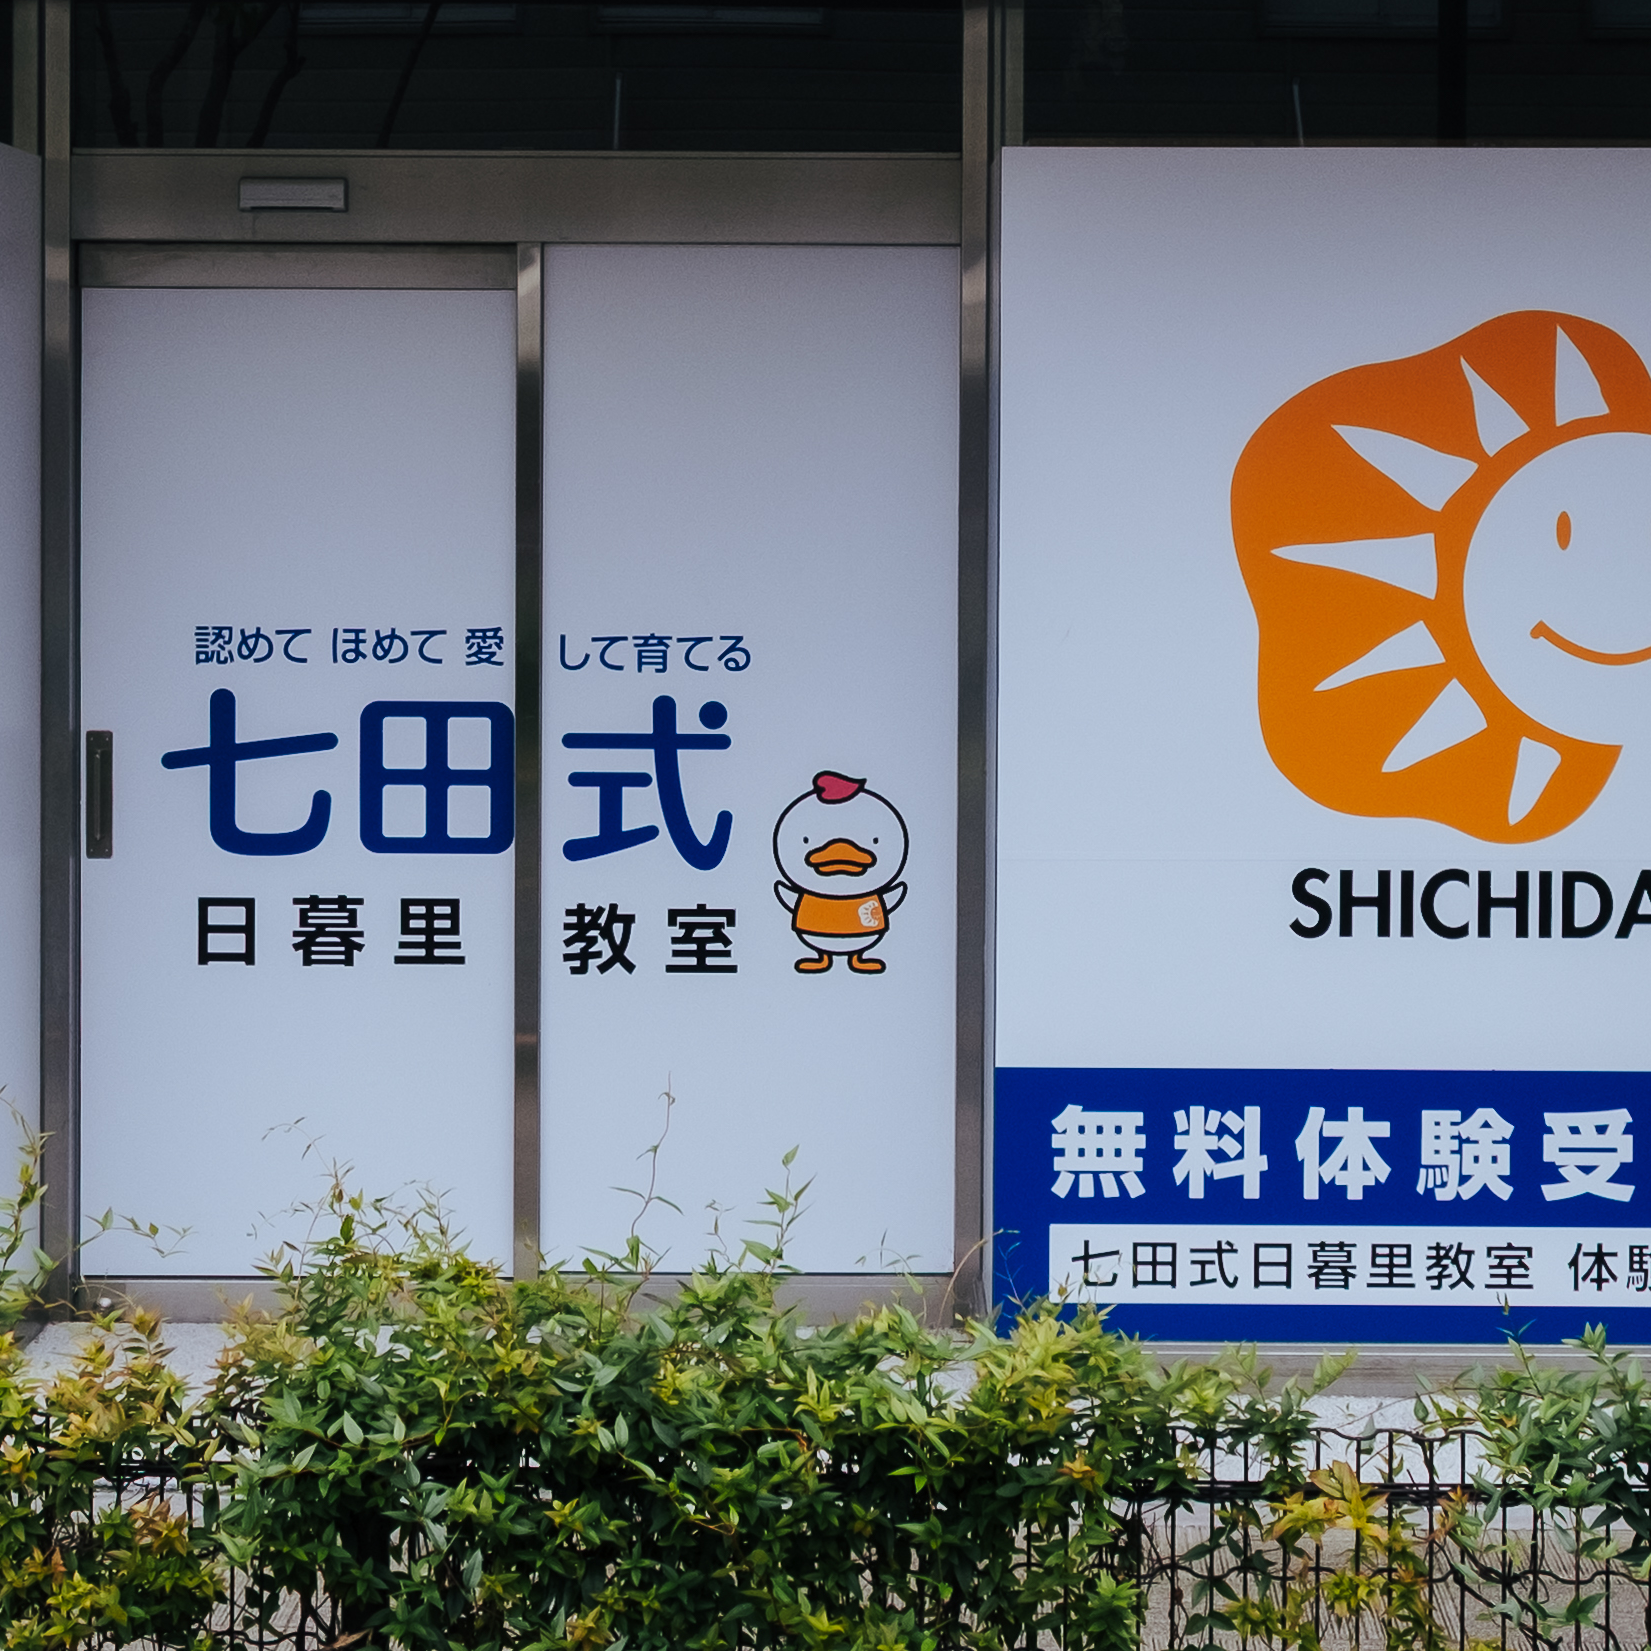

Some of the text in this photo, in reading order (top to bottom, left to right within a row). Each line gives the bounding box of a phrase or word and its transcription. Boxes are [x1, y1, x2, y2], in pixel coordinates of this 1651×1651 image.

[194, 626, 750, 673] 認めて ほめて 愛 して育てる
[1071, 1240, 1533, 1291] 七田式日暮里教室
